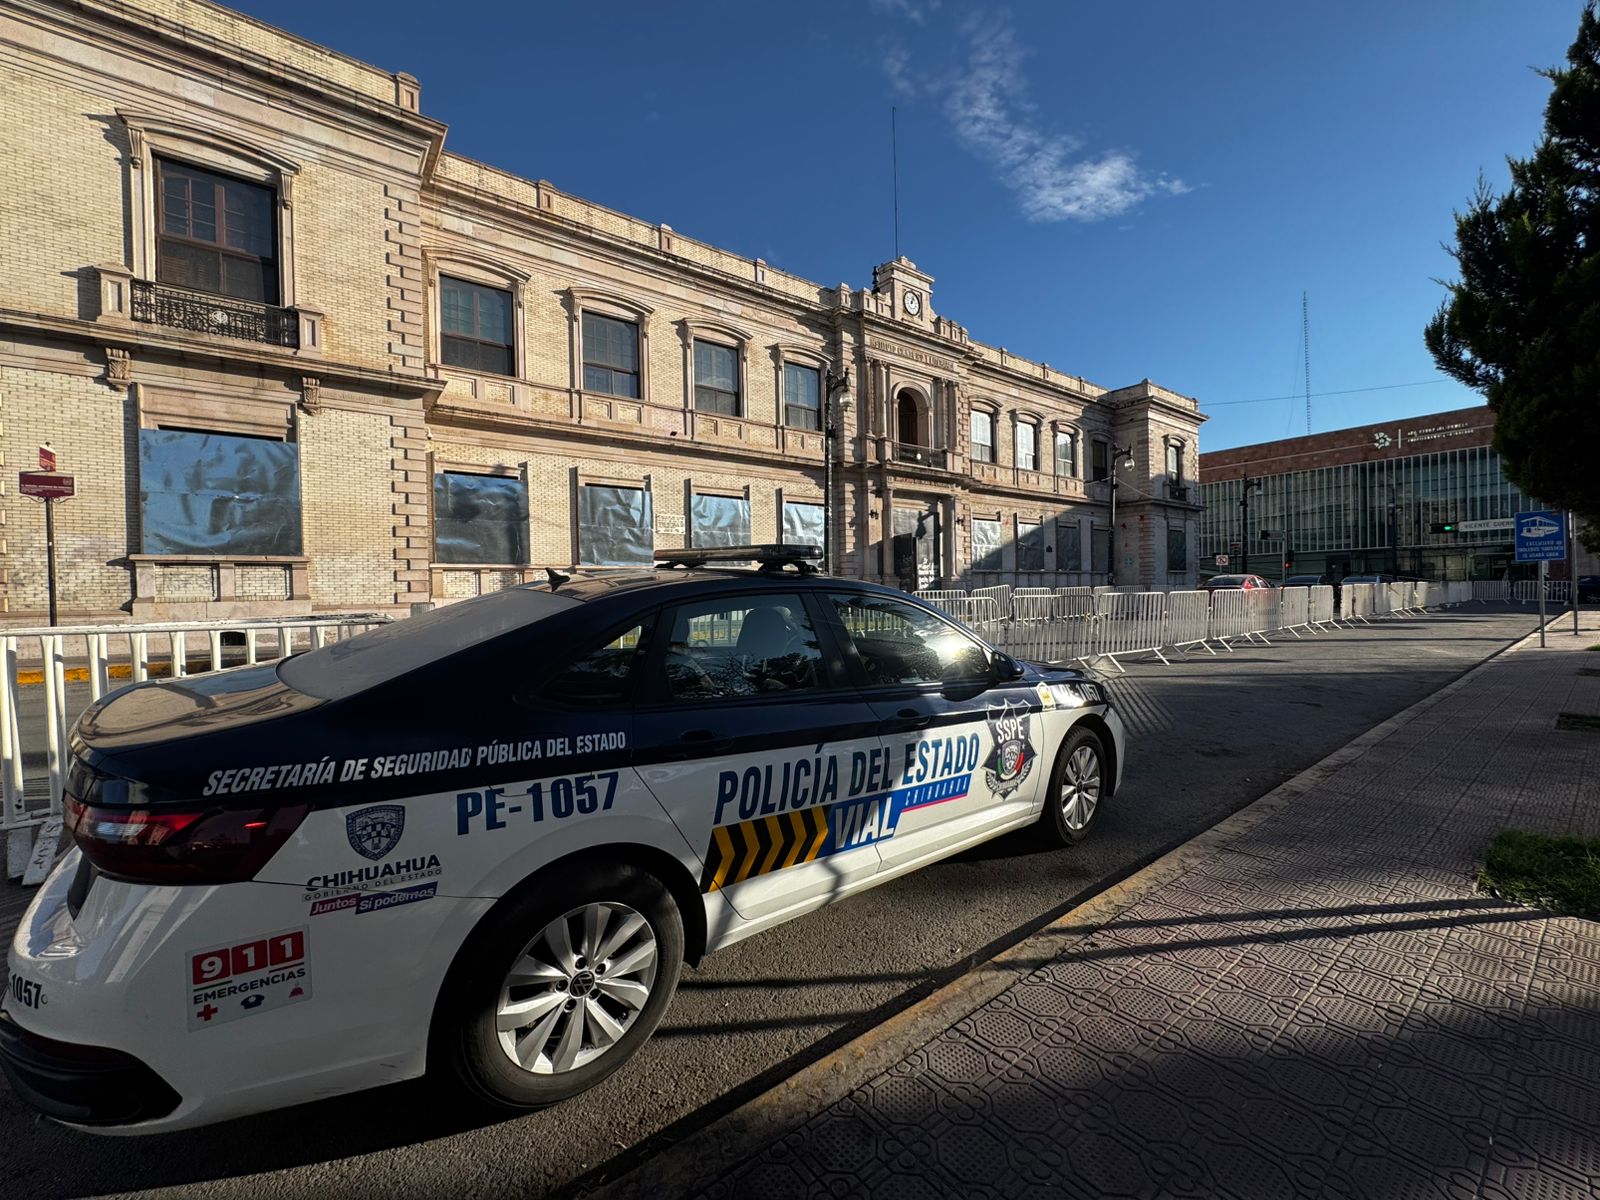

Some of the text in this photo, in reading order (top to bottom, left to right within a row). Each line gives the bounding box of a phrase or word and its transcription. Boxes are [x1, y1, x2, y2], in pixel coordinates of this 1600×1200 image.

[1464, 521, 1490, 529] VICENTE
[995, 718, 1025, 743] SSPE
[203, 731, 626, 796] SECRETARÍA DE SEGURIDAD PÚBLICA DEL ESTADO
[713, 743, 838, 825] POLICÍA
[848, 746, 893, 797] DEL
[901, 732, 980, 785] ESTADO
[456, 771, 619, 836] PE-1057
[835, 796, 895, 849] VIAL
[305, 854, 440, 892] CHIHUAHUA
[375, 878, 395, 888] DEL
[401, 869, 441, 881] ESTADO
[311, 896, 357, 914] Juntos
[374, 887, 434, 909] podemos
[200, 937, 293, 980] 911
[193, 967, 306, 1005] EMERGENCIAS
